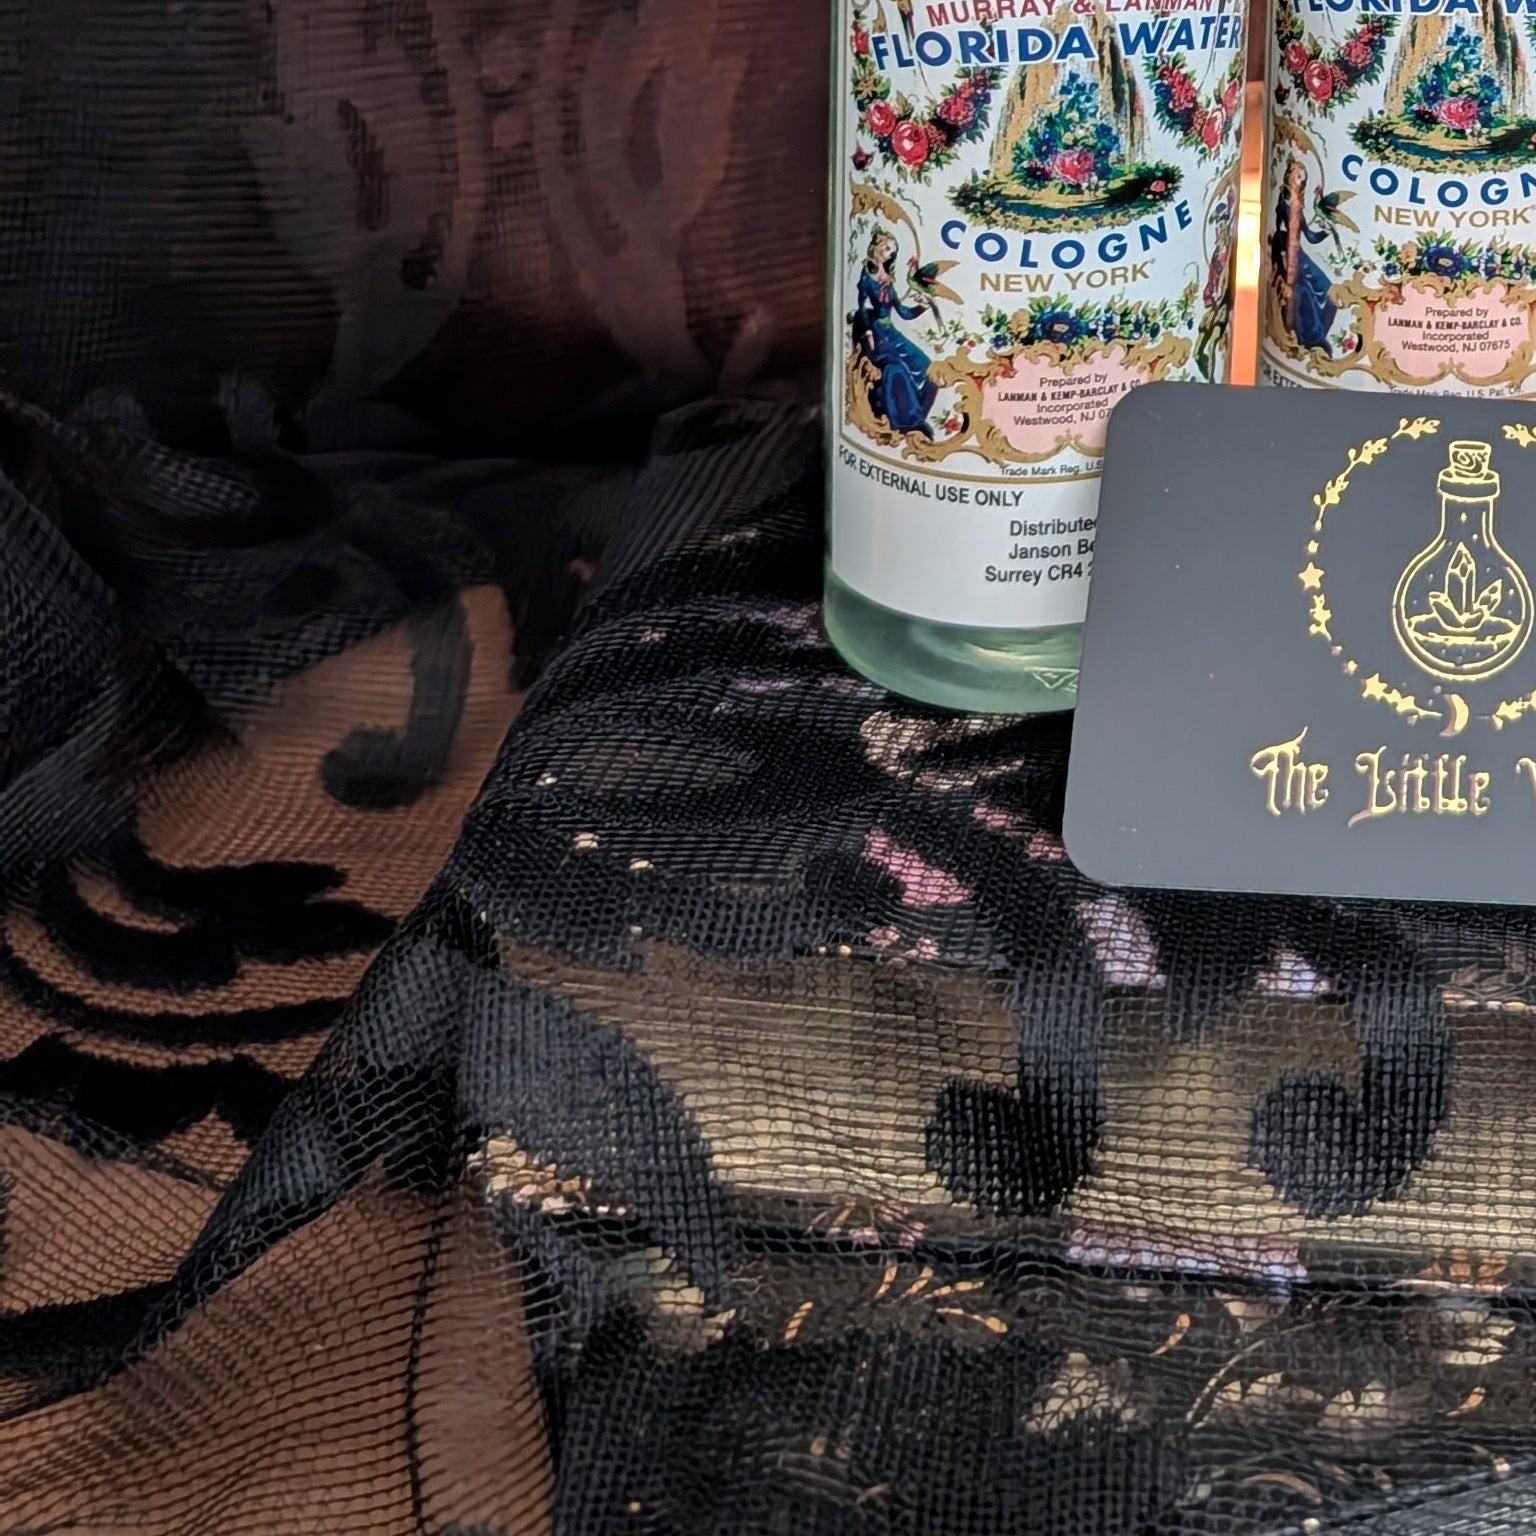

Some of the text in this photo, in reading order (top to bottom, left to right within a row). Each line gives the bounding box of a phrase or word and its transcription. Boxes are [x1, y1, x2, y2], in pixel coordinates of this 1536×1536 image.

[872, 14, 1242, 71] FLORIDA WATER
[1373, 204, 1533, 229] NEW YORK
[940, 199, 1194, 269] COLOGNE
[979, 261, 1150, 293] NEW YORK
[1425, 306, 1489, 318] Prepared by
[1388, 317, 1423, 329] LANMAN
[1422, 331, 1490, 342] Incorporated
[1402, 340, 1511, 353] Westwood, NJ 07675
[1040, 372, 1108, 388] Prepared by
[998, 392, 1037, 402] LANMAN
[1037, 397, 1108, 414] Incorporated
[1014, 414, 1077, 426] Westwood,
[1080, 411, 1096, 422] NJ
[838, 444, 1024, 507] FOR EXTERNAL USE ONLY
[1001, 464, 1028, 476] Trade
[1032, 464, 1057, 475] Mark
[1009, 543, 1071, 559] Janson
[985, 565, 1042, 586] Surrey
[1048, 562, 1083, 581] CR4
[1250, 725, 1329, 818] The
[1347, 745, 1492, 829] Little
